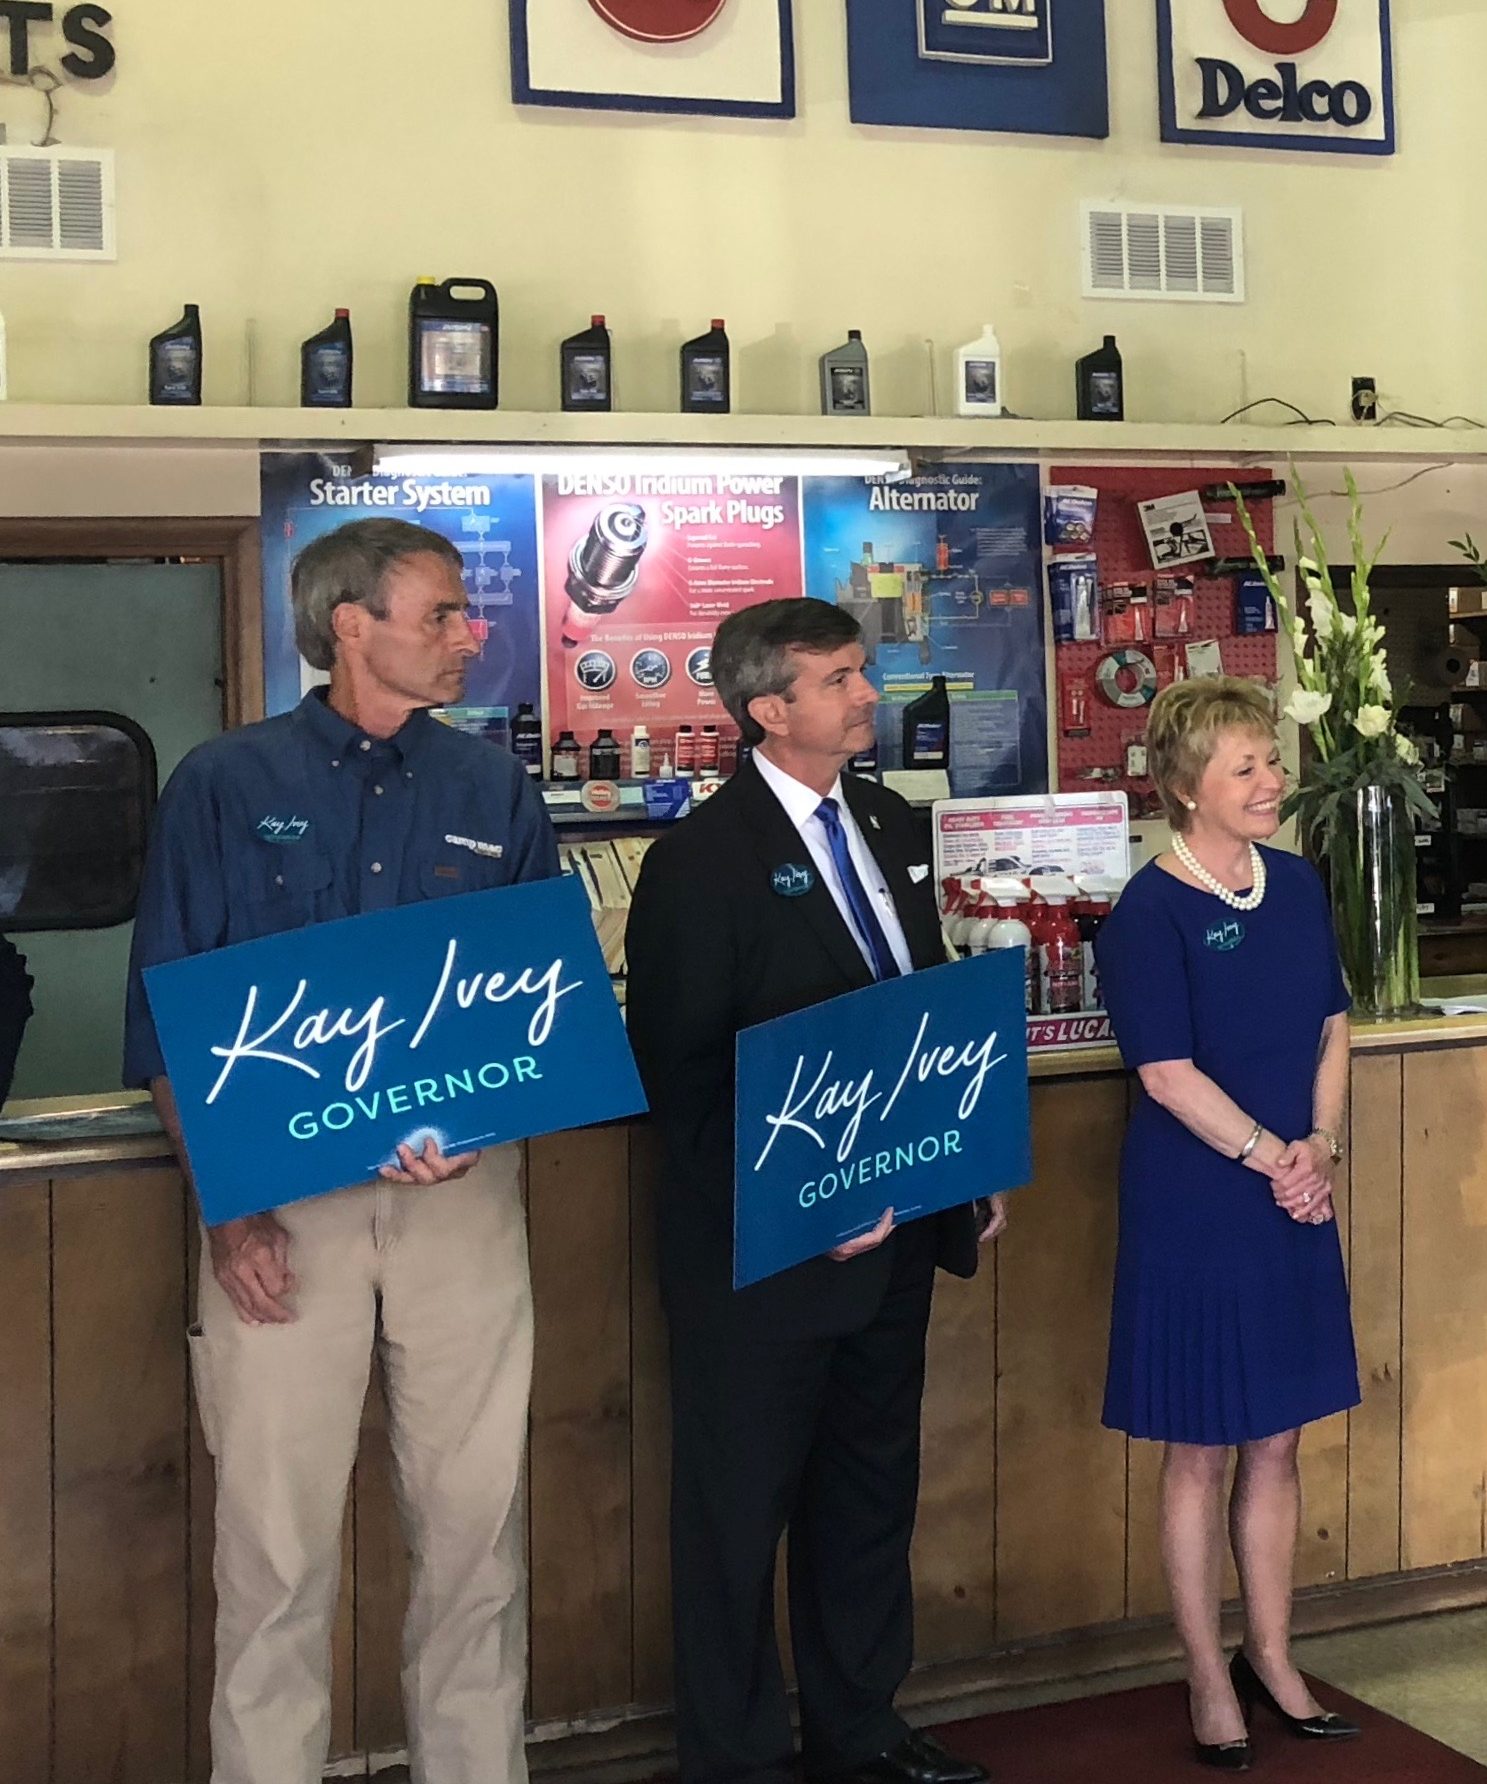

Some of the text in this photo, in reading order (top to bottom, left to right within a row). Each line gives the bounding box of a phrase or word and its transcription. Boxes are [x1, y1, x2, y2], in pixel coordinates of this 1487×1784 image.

[1195, 56, 1371, 127] Delco
[310, 478, 491, 513] Starter System
[661, 499, 785, 531] Spark Plugs
[869, 486, 980, 511] Alternator
[257, 815, 285, 834] Kay
[205, 938, 584, 1105] Kay Ivey
[1057, 1018, 1116, 1041] LUCA
[288, 1056, 543, 1140] GOVERNOR
[754, 1012, 1008, 1171] Kay Ivey
[799, 1129, 963, 1208] GOVERNOR
